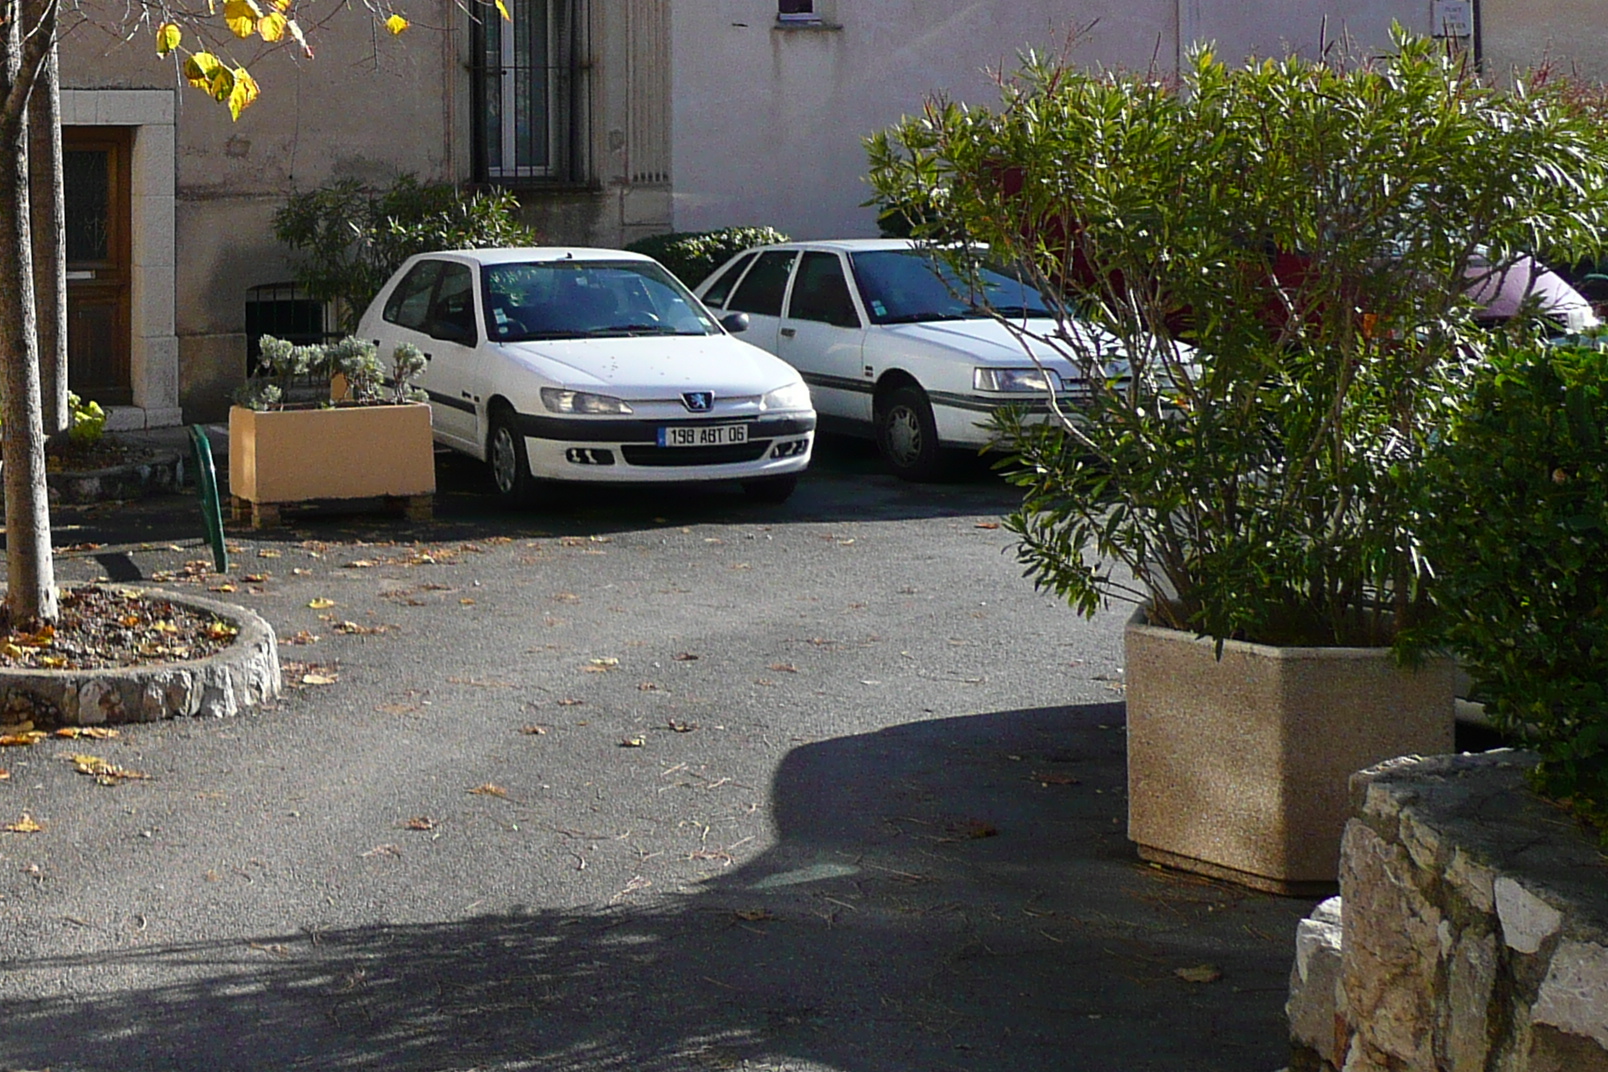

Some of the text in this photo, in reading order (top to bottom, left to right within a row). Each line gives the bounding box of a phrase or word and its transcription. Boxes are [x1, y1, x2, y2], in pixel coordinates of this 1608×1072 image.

[671, 426, 744, 444] 198 ABT 06
